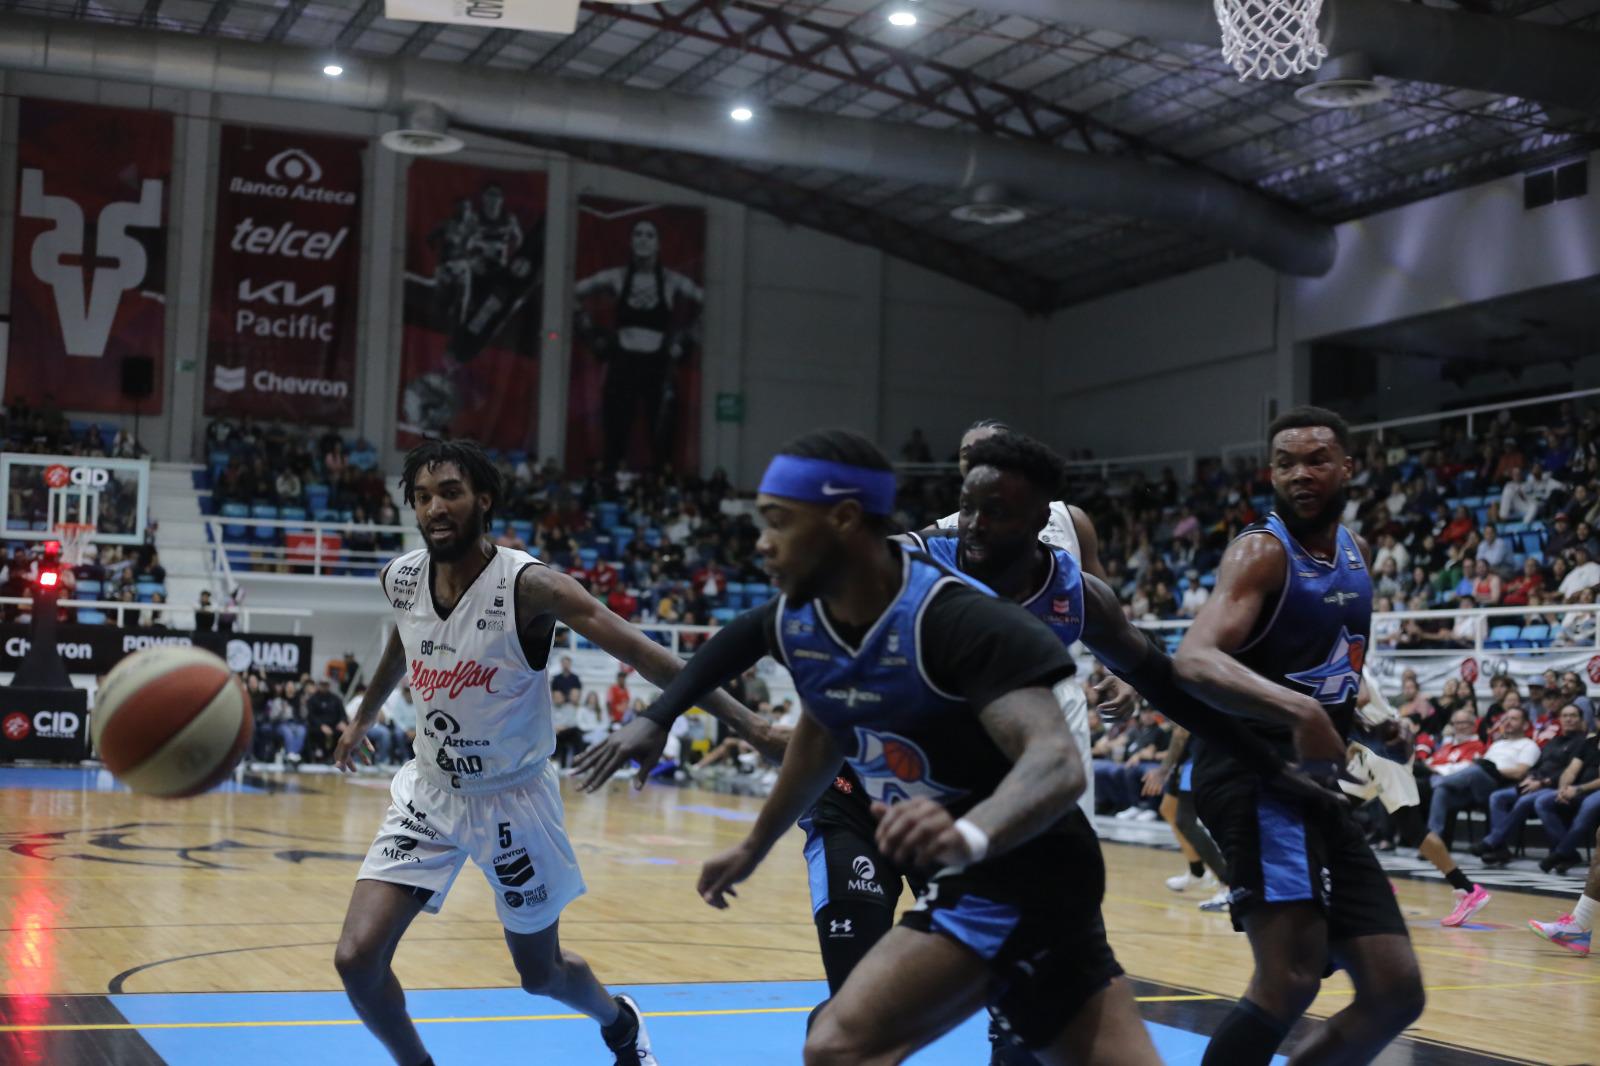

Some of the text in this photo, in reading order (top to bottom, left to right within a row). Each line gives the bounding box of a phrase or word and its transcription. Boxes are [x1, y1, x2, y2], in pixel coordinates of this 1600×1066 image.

[229, 177, 356, 205] Banco Azteca
[230, 217, 348, 260] telcel
[236, 310, 333, 341] Pacific
[253, 370, 348, 399] Chevron
[70, 467, 109, 487] CID
[252, 641, 299, 666] UAD
[33, 711, 80, 733] CID
[442, 735, 490, 748] Azteca
[400, 817, 437, 840] Huichol
[498, 822, 512, 849] 5
[848, 879, 884, 895] MEGA
